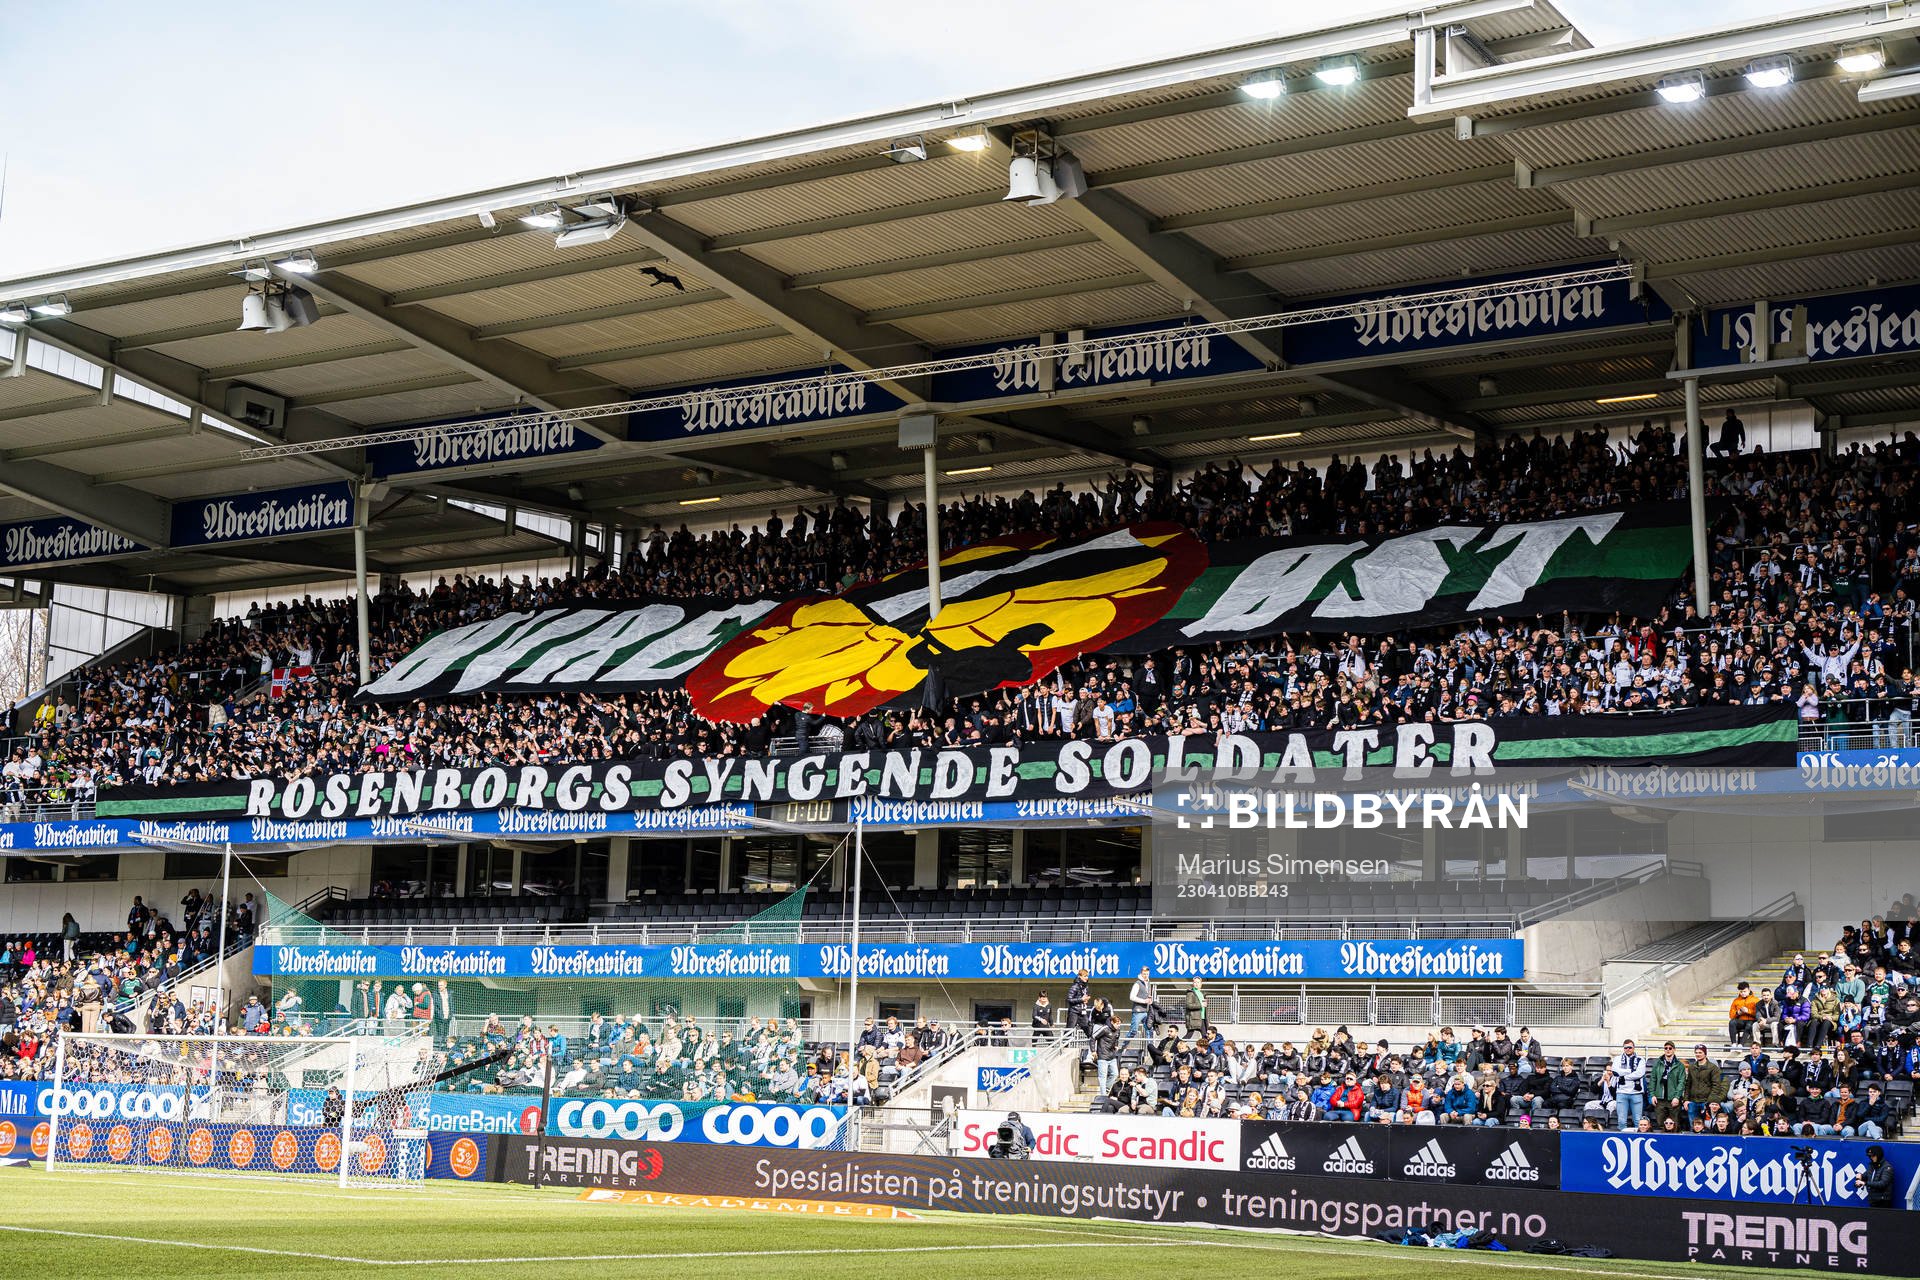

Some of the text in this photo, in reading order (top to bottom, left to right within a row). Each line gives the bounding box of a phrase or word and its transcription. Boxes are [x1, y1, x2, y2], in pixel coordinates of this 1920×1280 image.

[1353, 277, 1606, 347] Adresseavisen
[681, 380, 867, 433] Adresseavisen
[414, 414, 576, 467] Adresseavisen
[203, 493, 348, 540] Adresseavisen
[244, 717, 1497, 819] ROSENBORGS SYNGENDE SOLDATER
[497, 806, 607, 833] Adresseavisen
[786, 800, 832, 822] 0:00
[34, 822, 119, 848] Adresseavisen
[251, 816, 347, 841] Adresseavisen
[278, 946, 377, 975] Adresseavisen
[401, 946, 506, 975] Adresseavisen
[531, 945, 644, 977] Adresseavisen
[670, 945, 791, 977] Adresseavisen
[820, 945, 950, 977] Adesseavisen
[980, 944, 1120, 978] Adresseavisen
[1153, 943, 1304, 977] Adresseavisen
[1341, 941, 1504, 977] Adresseavisen
[420, 1107, 518, 1134] SpareBank
[527, 1111, 538, 1133] 1
[963, 1123, 1079, 1157] Scdic
[1102, 1128, 1225, 1163] Scandic
[525, 1144, 638, 1177] TRENING
[1246, 1155, 1296, 1171] adidas
[1323, 1158, 1374, 1175] adidas
[1403, 1161, 1456, 1178] adidas
[1485, 1165, 1539, 1182] adidas
[528, 1172, 637, 1187] PARTNER
[632, 1193, 885, 1216] AKADEMIET
[755, 1159, 1547, 1238] Spesialisten på treningsutstyr treningspartner.no
[1681, 1211, 1868, 1255] TRENING
[1688, 1246, 1868, 1269] PARTNER
